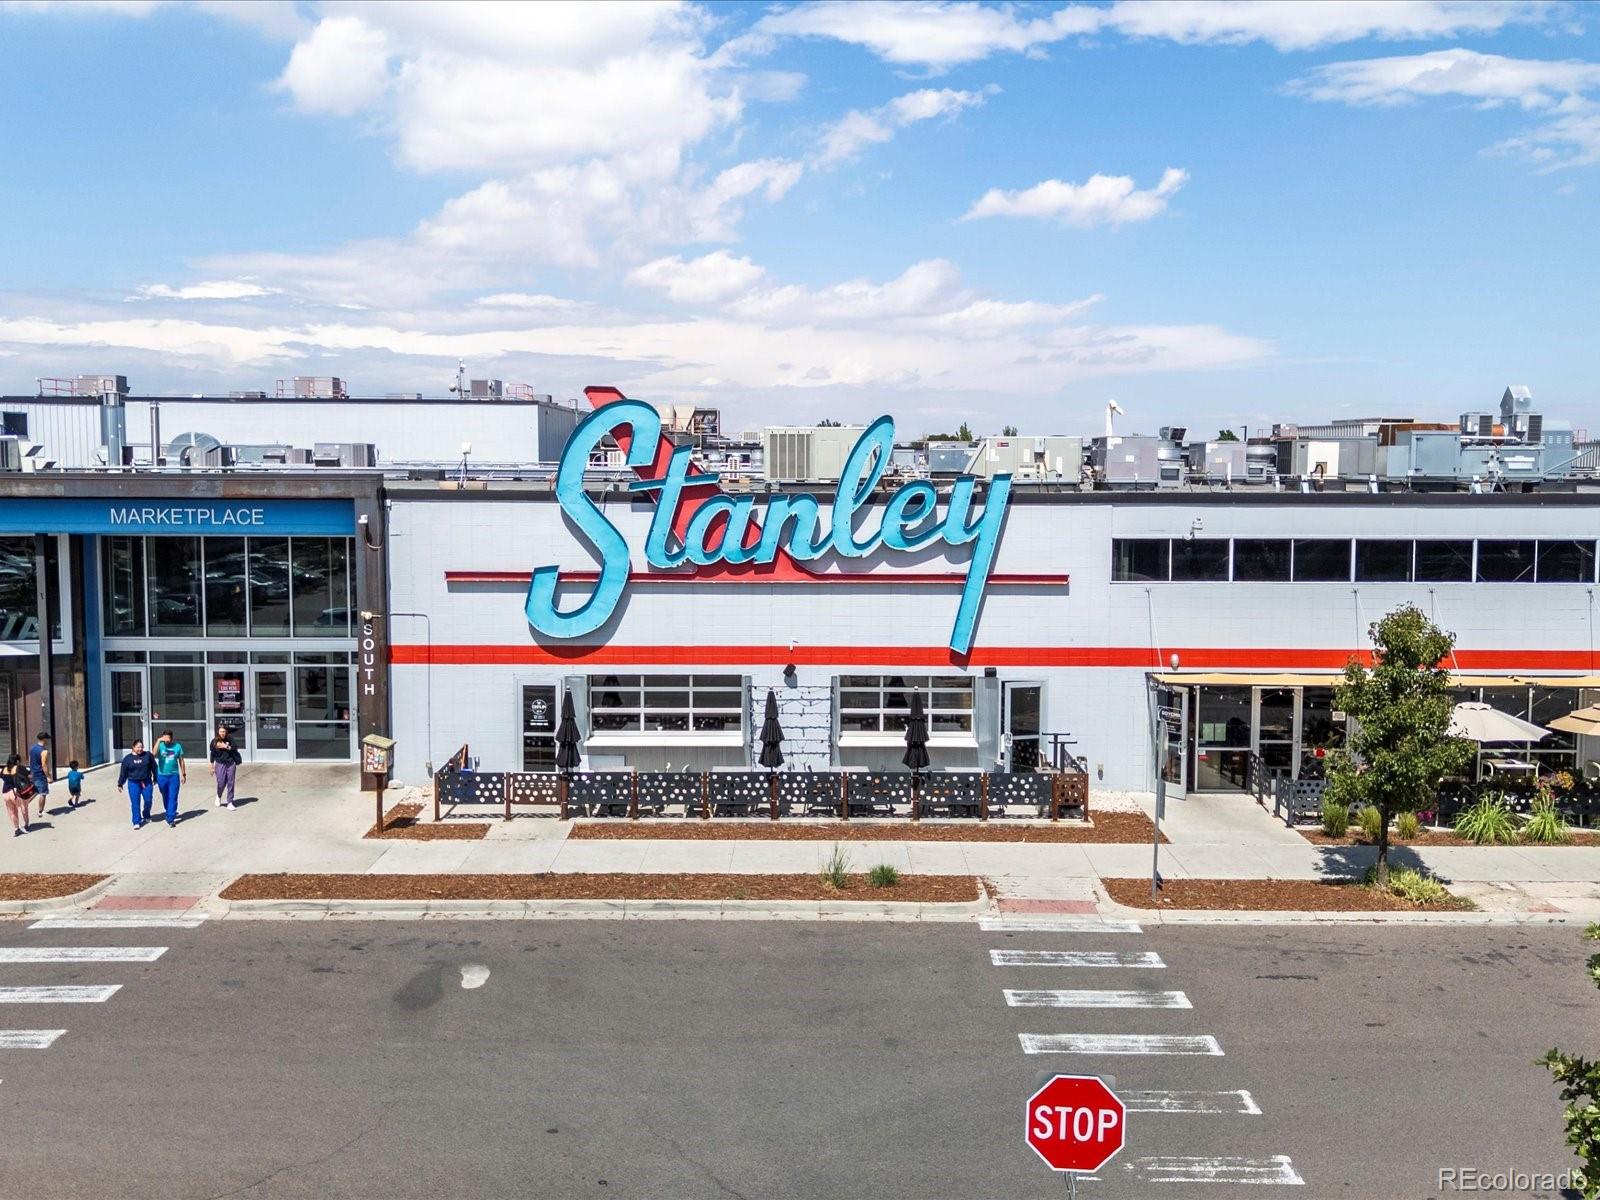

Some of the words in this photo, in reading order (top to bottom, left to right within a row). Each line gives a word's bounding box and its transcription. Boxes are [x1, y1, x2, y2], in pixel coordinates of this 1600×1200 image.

[110, 507, 265, 525] MARKETPLACE
[525, 399, 1013, 655] Stanley
[363, 623, 375, 696] SOUTH
[1033, 1104, 1118, 1143] STOP
